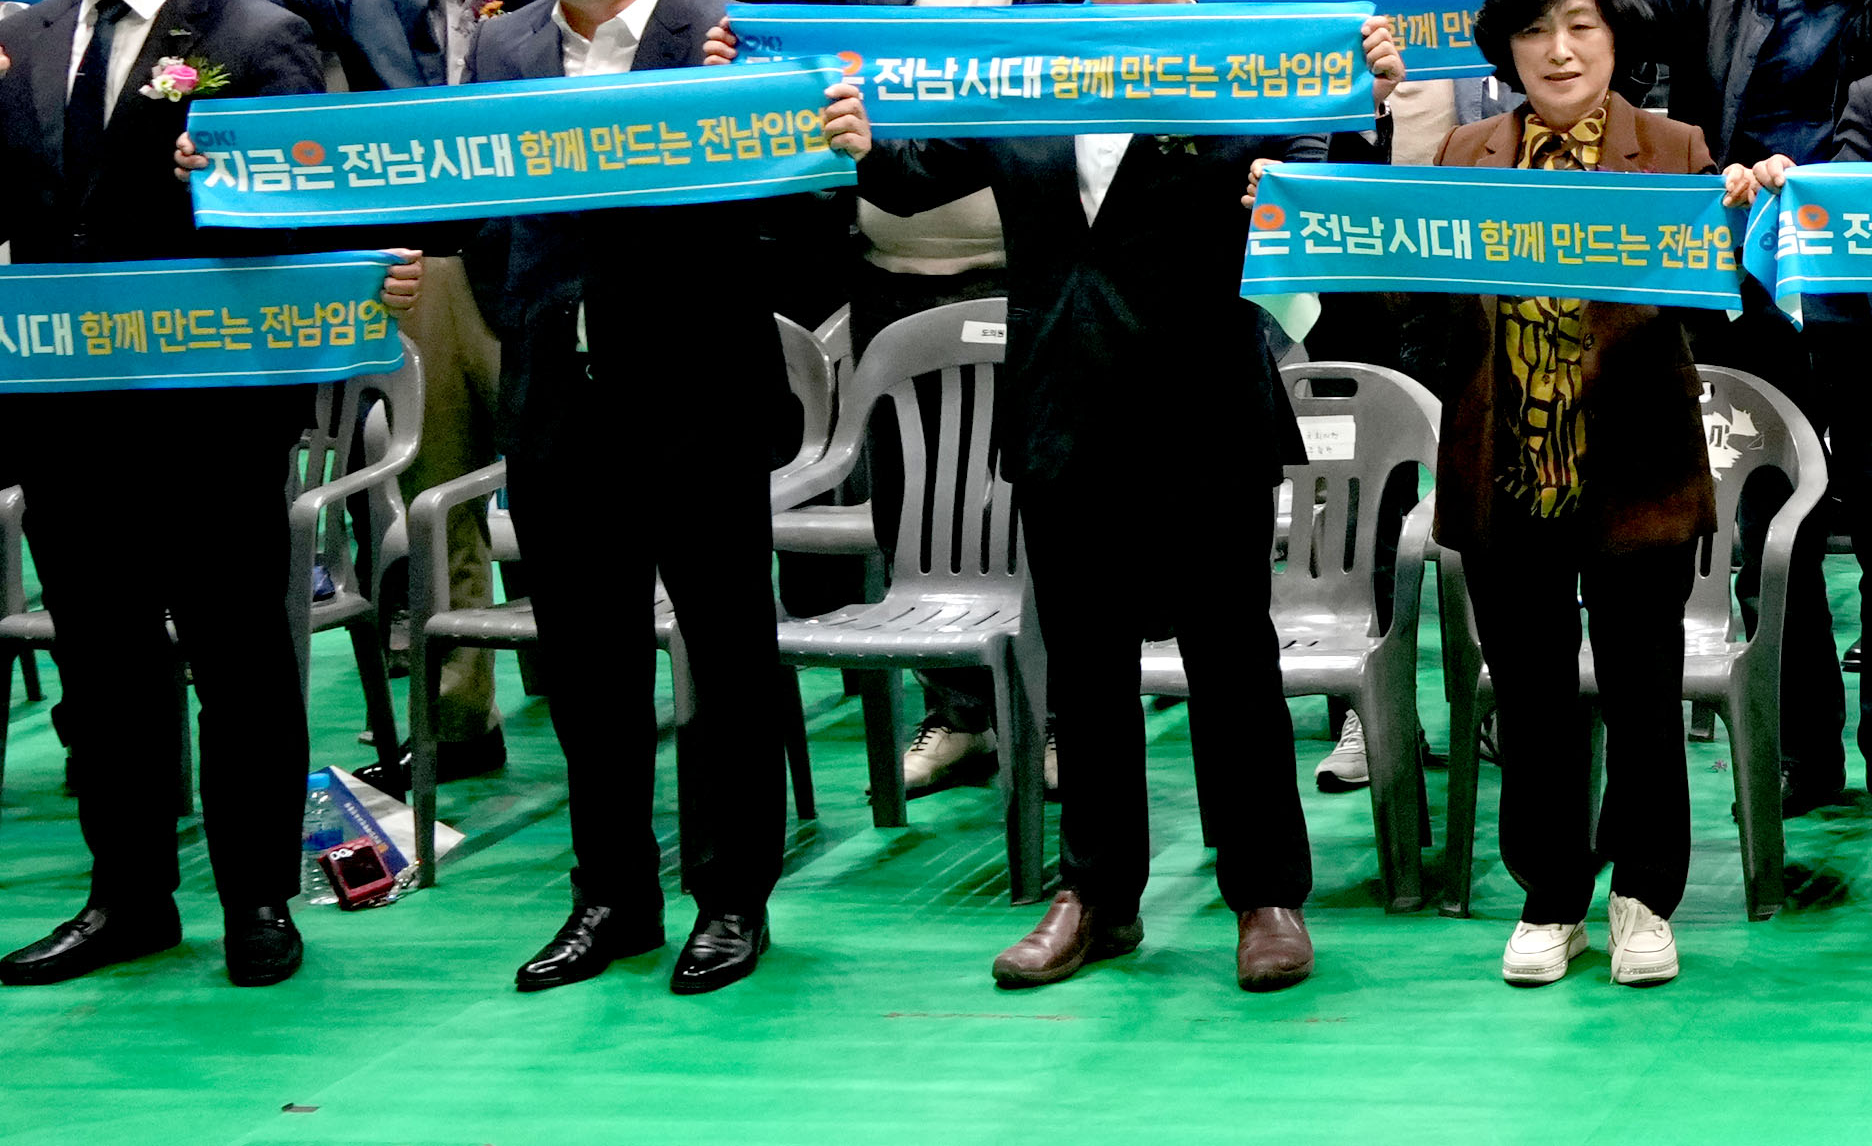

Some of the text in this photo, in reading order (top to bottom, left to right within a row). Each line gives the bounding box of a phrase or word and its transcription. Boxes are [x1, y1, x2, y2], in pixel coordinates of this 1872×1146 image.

[873, 50, 1354, 103] 전남시대 함께 만드는 전남임업
[203, 108, 826, 193] 지금은 전남시대 함께 만드는 전남임업
[1300, 210, 1648, 268] 전남시대 함께 만드는
[79, 298, 389, 356] 함께 만드는 전남임업
